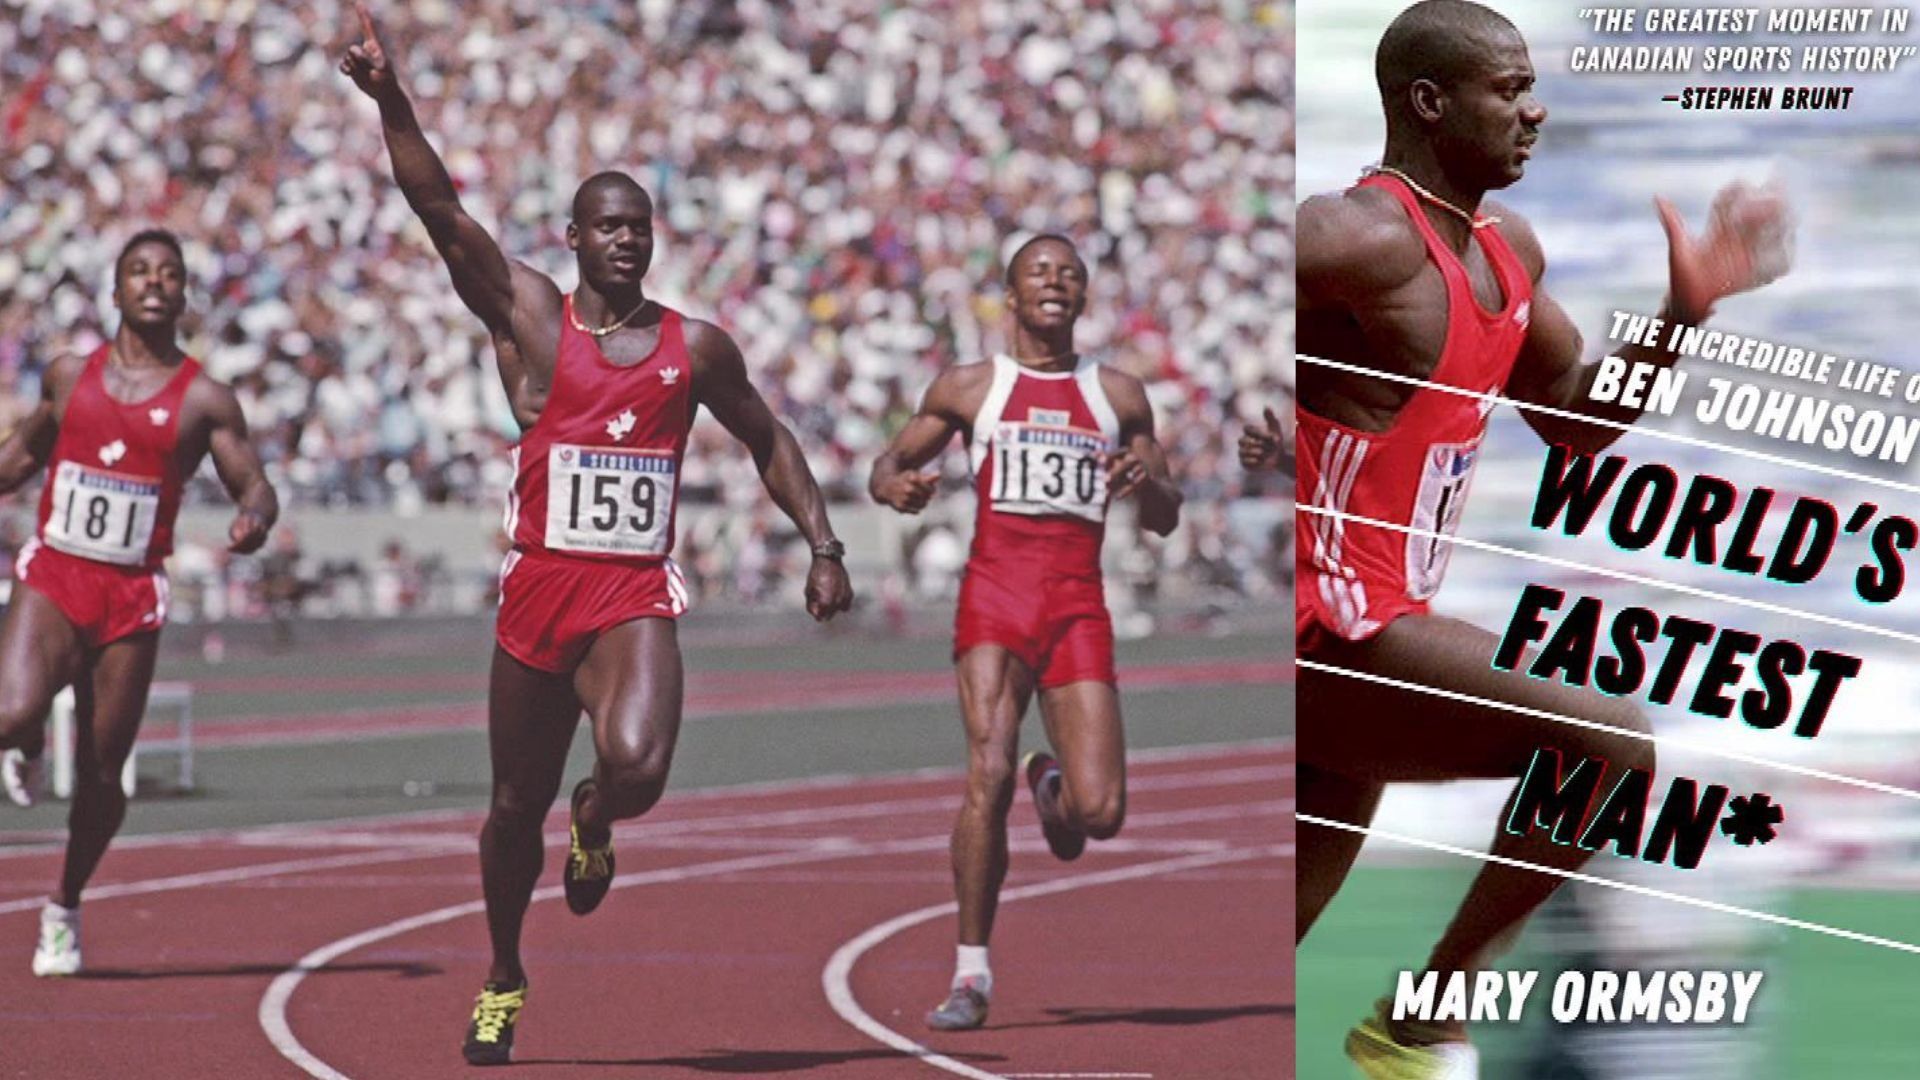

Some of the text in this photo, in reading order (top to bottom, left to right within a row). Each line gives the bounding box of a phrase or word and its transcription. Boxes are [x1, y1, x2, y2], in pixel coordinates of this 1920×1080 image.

[1578, 8, 1909, 32] "THE GREATEST MOMENT IN
[1571, 46, 1917, 72] CANADIAN SPORTS HISTORY"
[1780, 87, 1853, 110] BRUNT
[1608, 310, 1665, 348] THE
[1667, 323, 1836, 385] INCREDIBLE
[1838, 359, 1901, 398] LIFE
[1588, 355, 1920, 464] BEN JOHNSON
[569, 473, 656, 532] 159
[1001, 448, 1097, 504] 1130
[64, 488, 136, 548] 181
[1529, 442, 1919, 605] WORLD'S
[1492, 583, 1862, 739] FASTEST
[1391, 970, 1764, 1023] MARY ORMSBY
